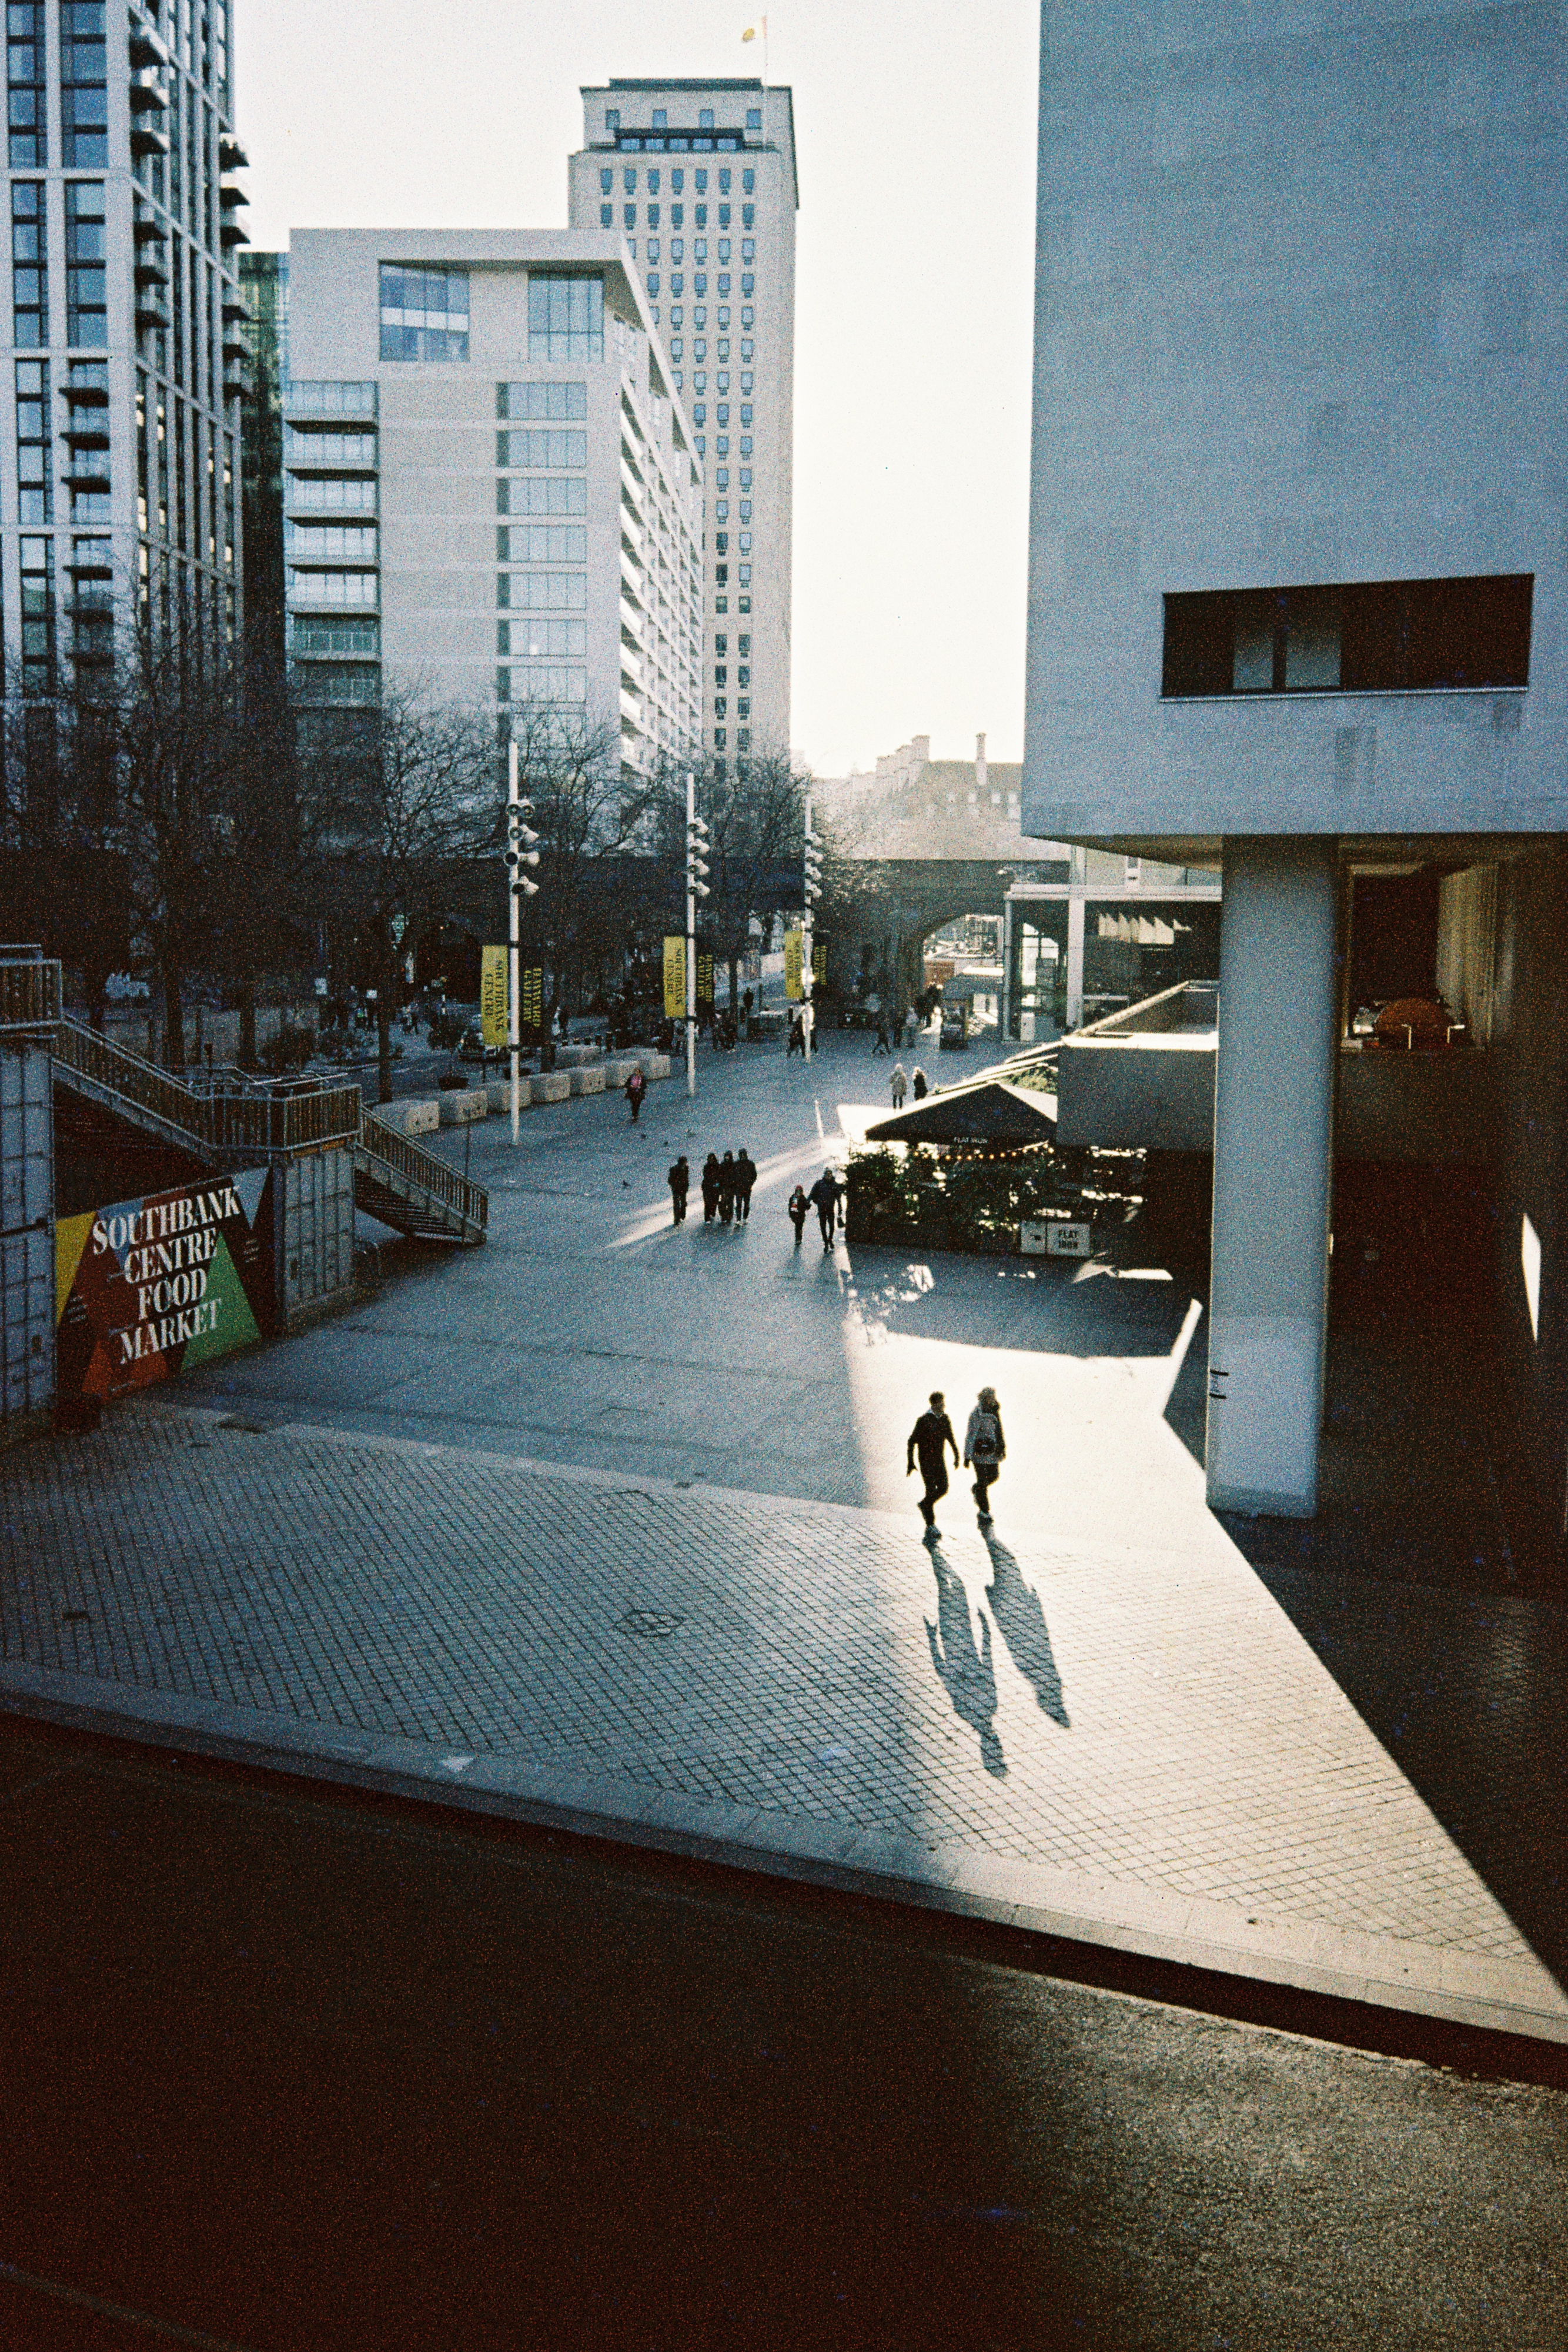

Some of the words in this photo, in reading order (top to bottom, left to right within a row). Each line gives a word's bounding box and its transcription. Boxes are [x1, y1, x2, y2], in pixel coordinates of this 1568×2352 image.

[92, 1186, 241, 1255] SOUTHBANK
[1058, 1230, 1078, 1238] FLAT
[124, 1227, 218, 1284] CENTRE
[138, 1268, 207, 1320] FOOD
[119, 1298, 222, 1364] MARKET
